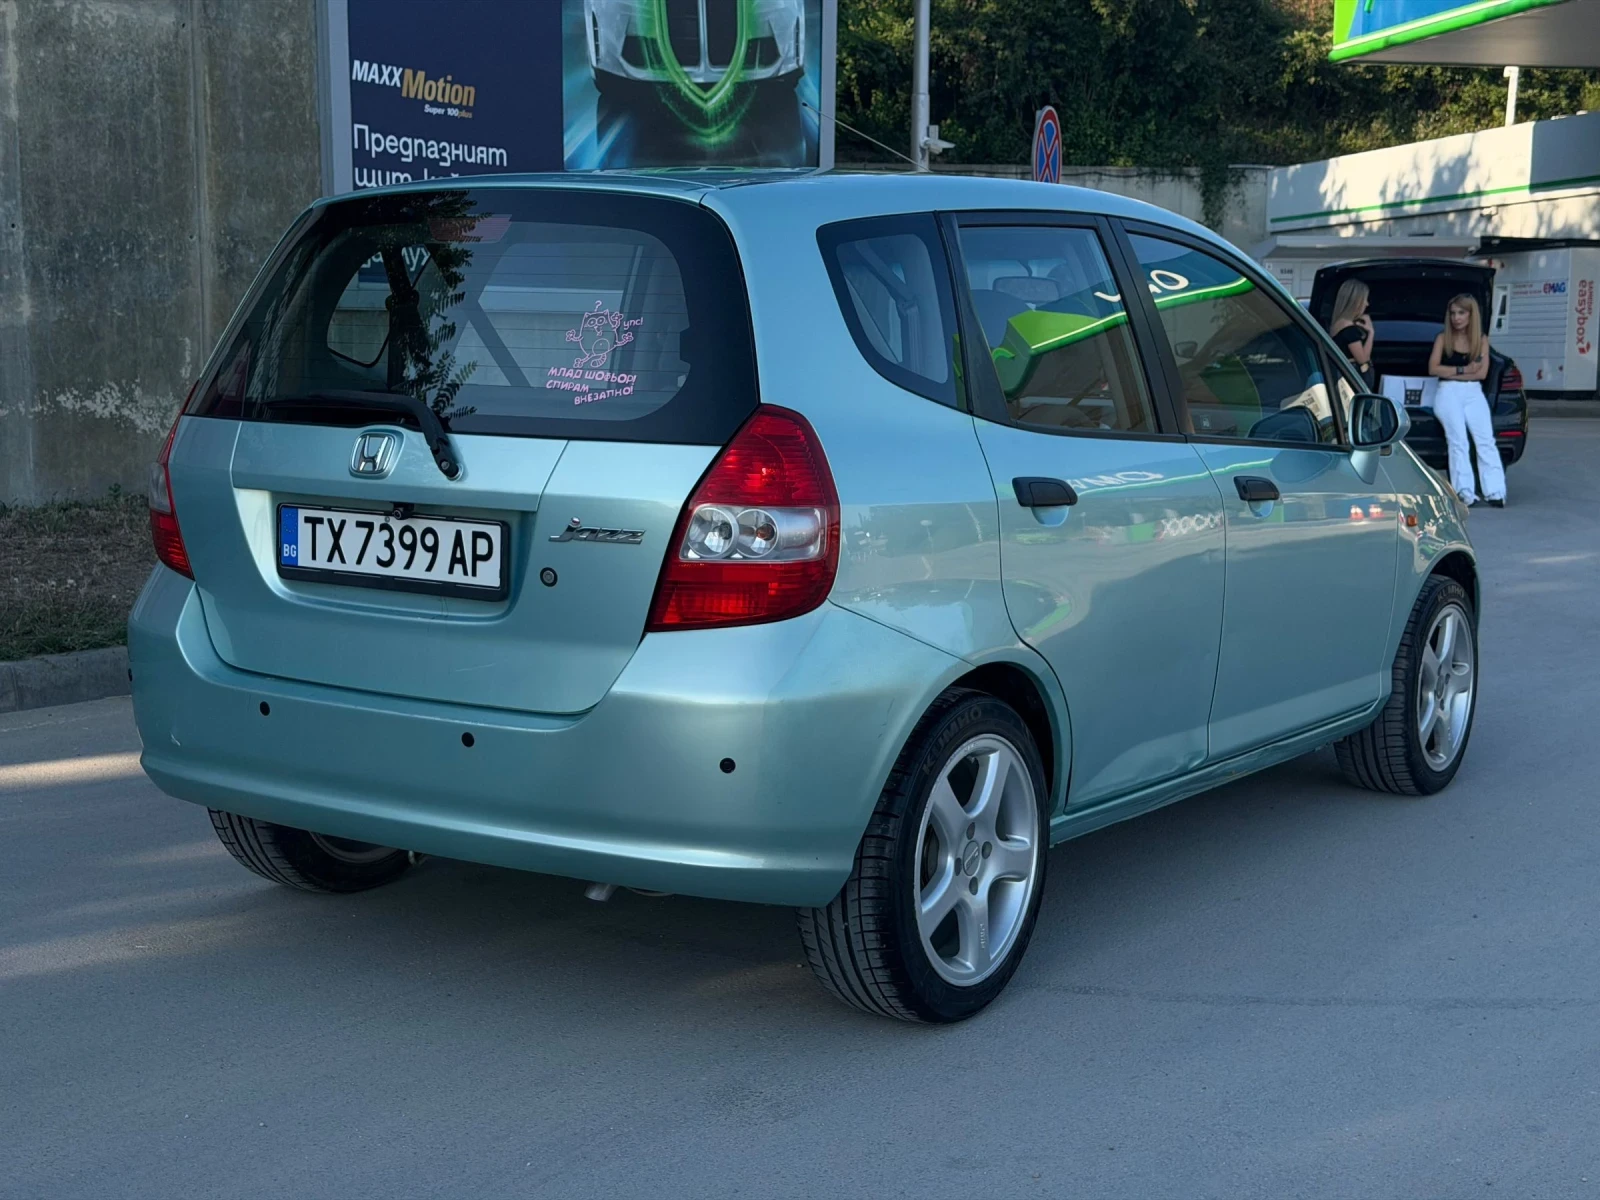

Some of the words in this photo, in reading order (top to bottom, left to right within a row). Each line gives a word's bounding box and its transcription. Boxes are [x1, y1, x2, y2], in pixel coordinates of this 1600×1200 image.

[424, 104, 445, 116] Super
[353, 123, 508, 167] Предпазният
[1575, 279, 1588, 345] easybox
[548, 366, 583, 379] МЛАД
[584, 371, 637, 385] ШОФЬОР!
[546, 379, 589, 393] СПИРАМ
[574, 386, 634, 405] ВНЕЗАПНО!
[283, 543, 297, 558] BG
[304, 515, 347, 564] TX
[355, 520, 440, 572] 7399
[447, 529, 494, 577] AP
[922, 705, 982, 775] KUMHO
